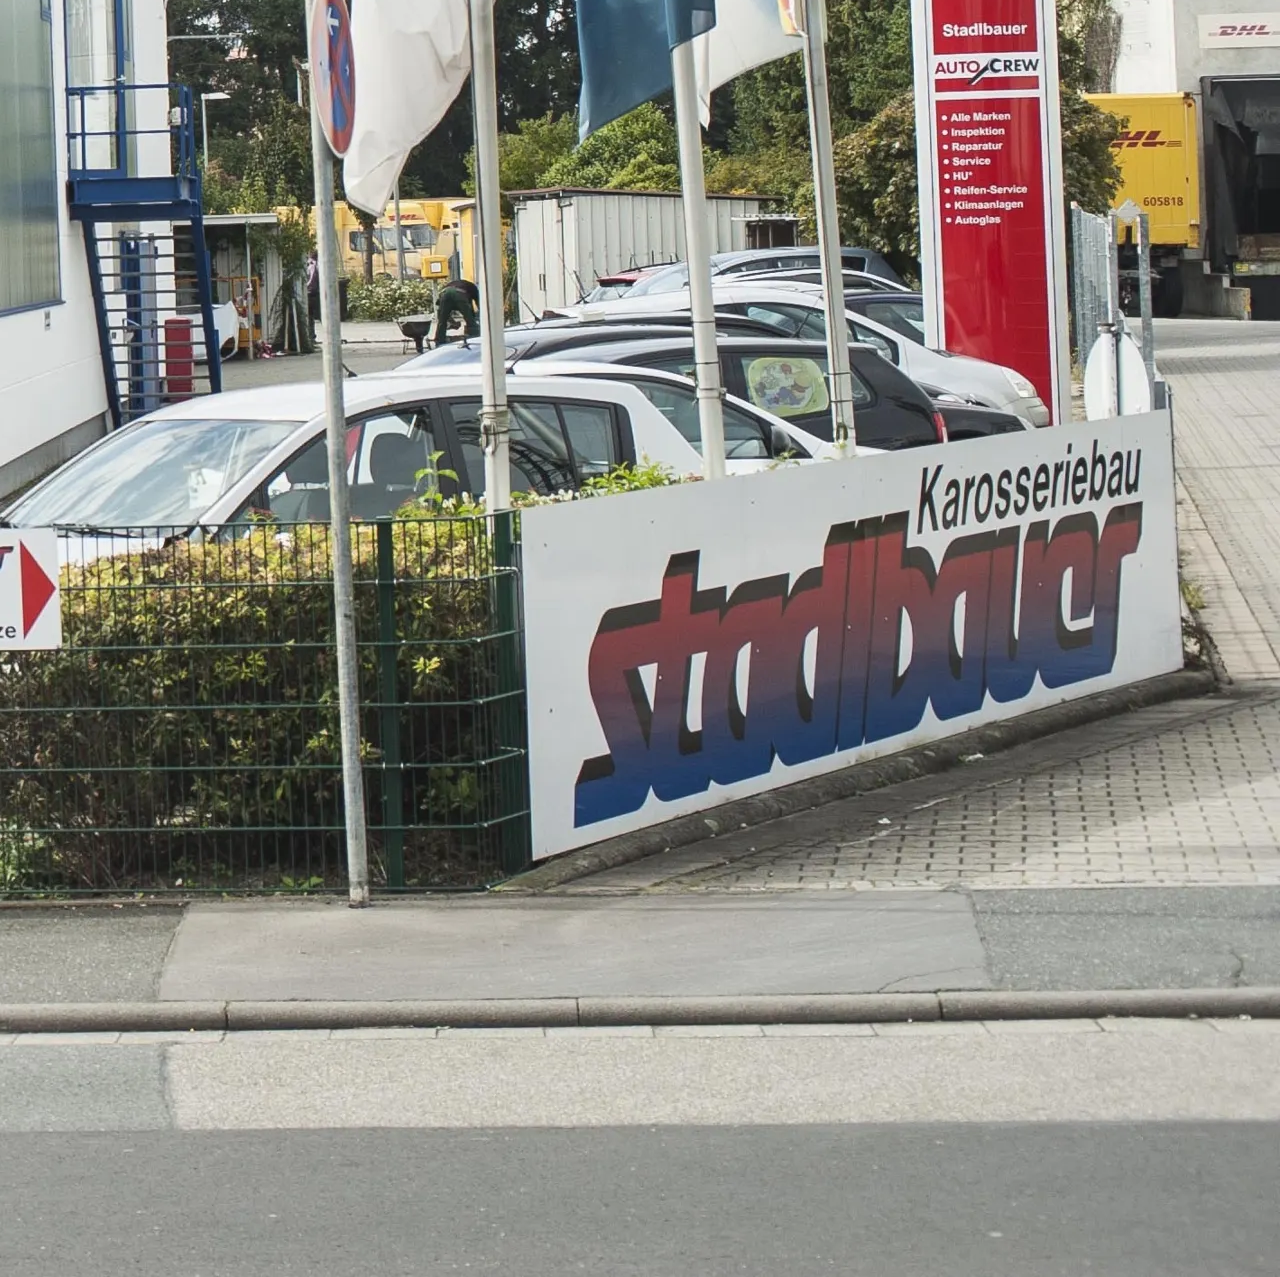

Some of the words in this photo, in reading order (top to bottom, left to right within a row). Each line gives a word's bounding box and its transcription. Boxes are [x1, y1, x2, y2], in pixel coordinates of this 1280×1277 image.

[942, 23, 1028, 38] Stadlbauer
[1219, 25, 1271, 36] DHL
[934, 60, 980, 75] AUTO
[990, 58, 1040, 73] CREW
[950, 112, 971, 122] Alle
[973, 111, 1011, 122] Marken
[951, 126, 1005, 137] Inspektion
[1110, 130, 1167, 148] HL
[952, 141, 1003, 152] Reparatur
[952, 156, 991, 166] Service
[953, 185, 1028, 195] Reifen-Service
[954, 200, 1024, 210] Klimaanlagen
[1143, 197, 1184, 207] 605818
[954, 215, 1001, 226] Autoglas
[917, 438, 1142, 534] Karosseriebau
